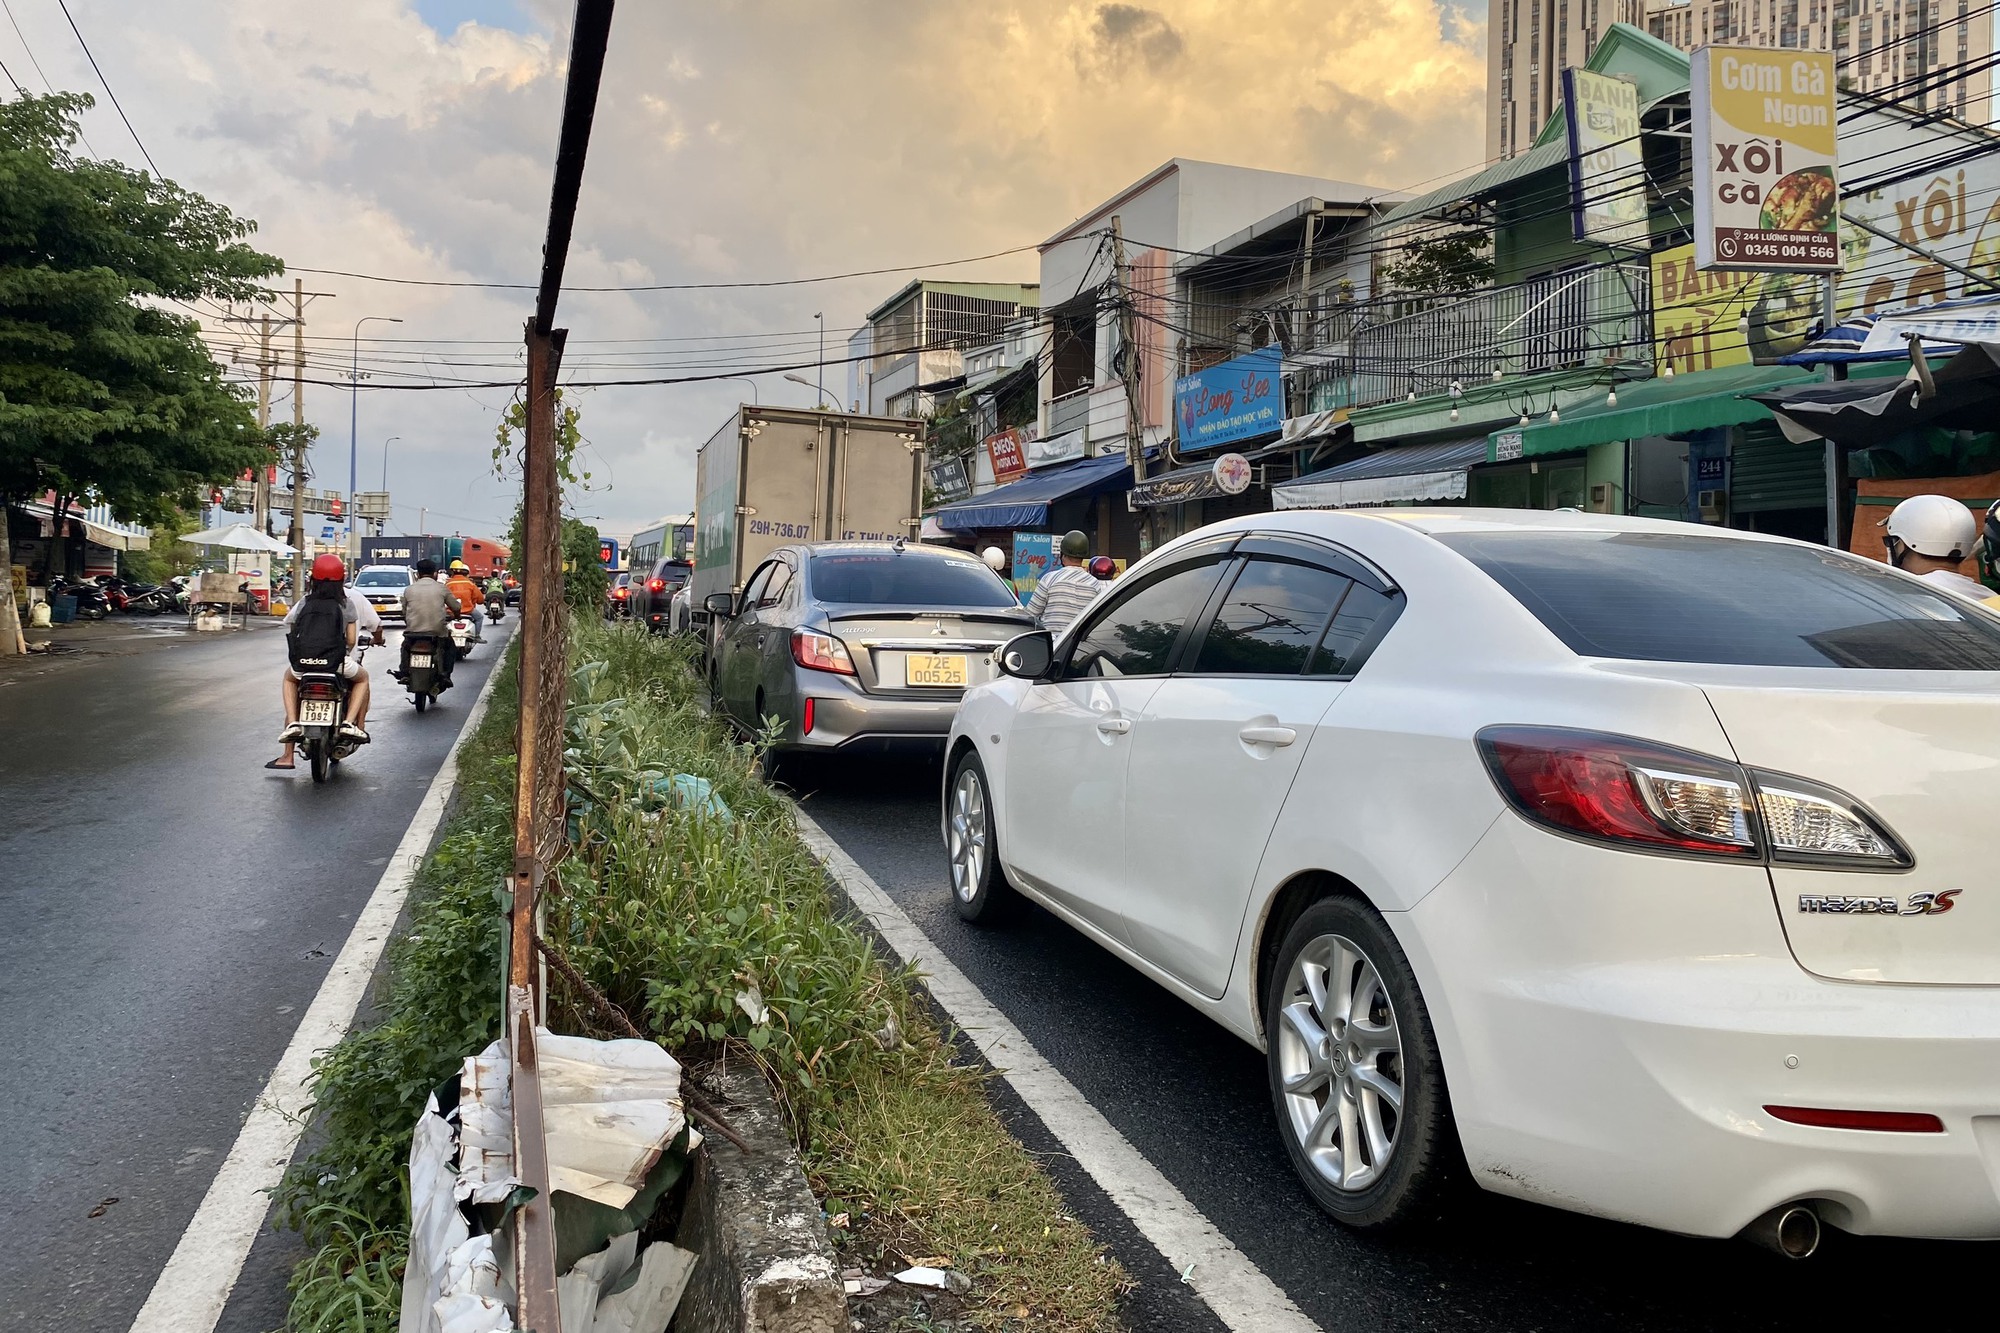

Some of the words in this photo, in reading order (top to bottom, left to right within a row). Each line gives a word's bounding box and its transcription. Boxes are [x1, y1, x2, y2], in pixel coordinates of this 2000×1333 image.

[1721, 56, 1782, 93] Cơm
[1791, 60, 1826, 96] Gà
[1763, 97, 1828, 128] Ngon
[1743, 232, 1759, 241] 244
[1811, 233, 1828, 243] CỦA
[1745, 244, 1778, 256] 0345
[1781, 245, 1807, 257] 004
[1810, 246, 1835, 259] 566
[1195, 386, 1235, 418] Long
[1241, 371, 1271, 405] Lee
[991, 436, 1016, 456] ENEOS
[997, 457, 1012, 469] MOTOR
[1011, 455, 1020, 465] OIL
[1701, 460, 1721, 473] 244
[749, 519, 810, 540] 29H-736.07
[1016, 534, 1031, 542] Hair
[1032, 535, 1051, 543] Salon
[1016, 548, 1048, 569] Long
[924, 656, 950, 669] 72E
[914, 670, 961, 684] 005.25
[1798, 893, 1899, 916] mazda
